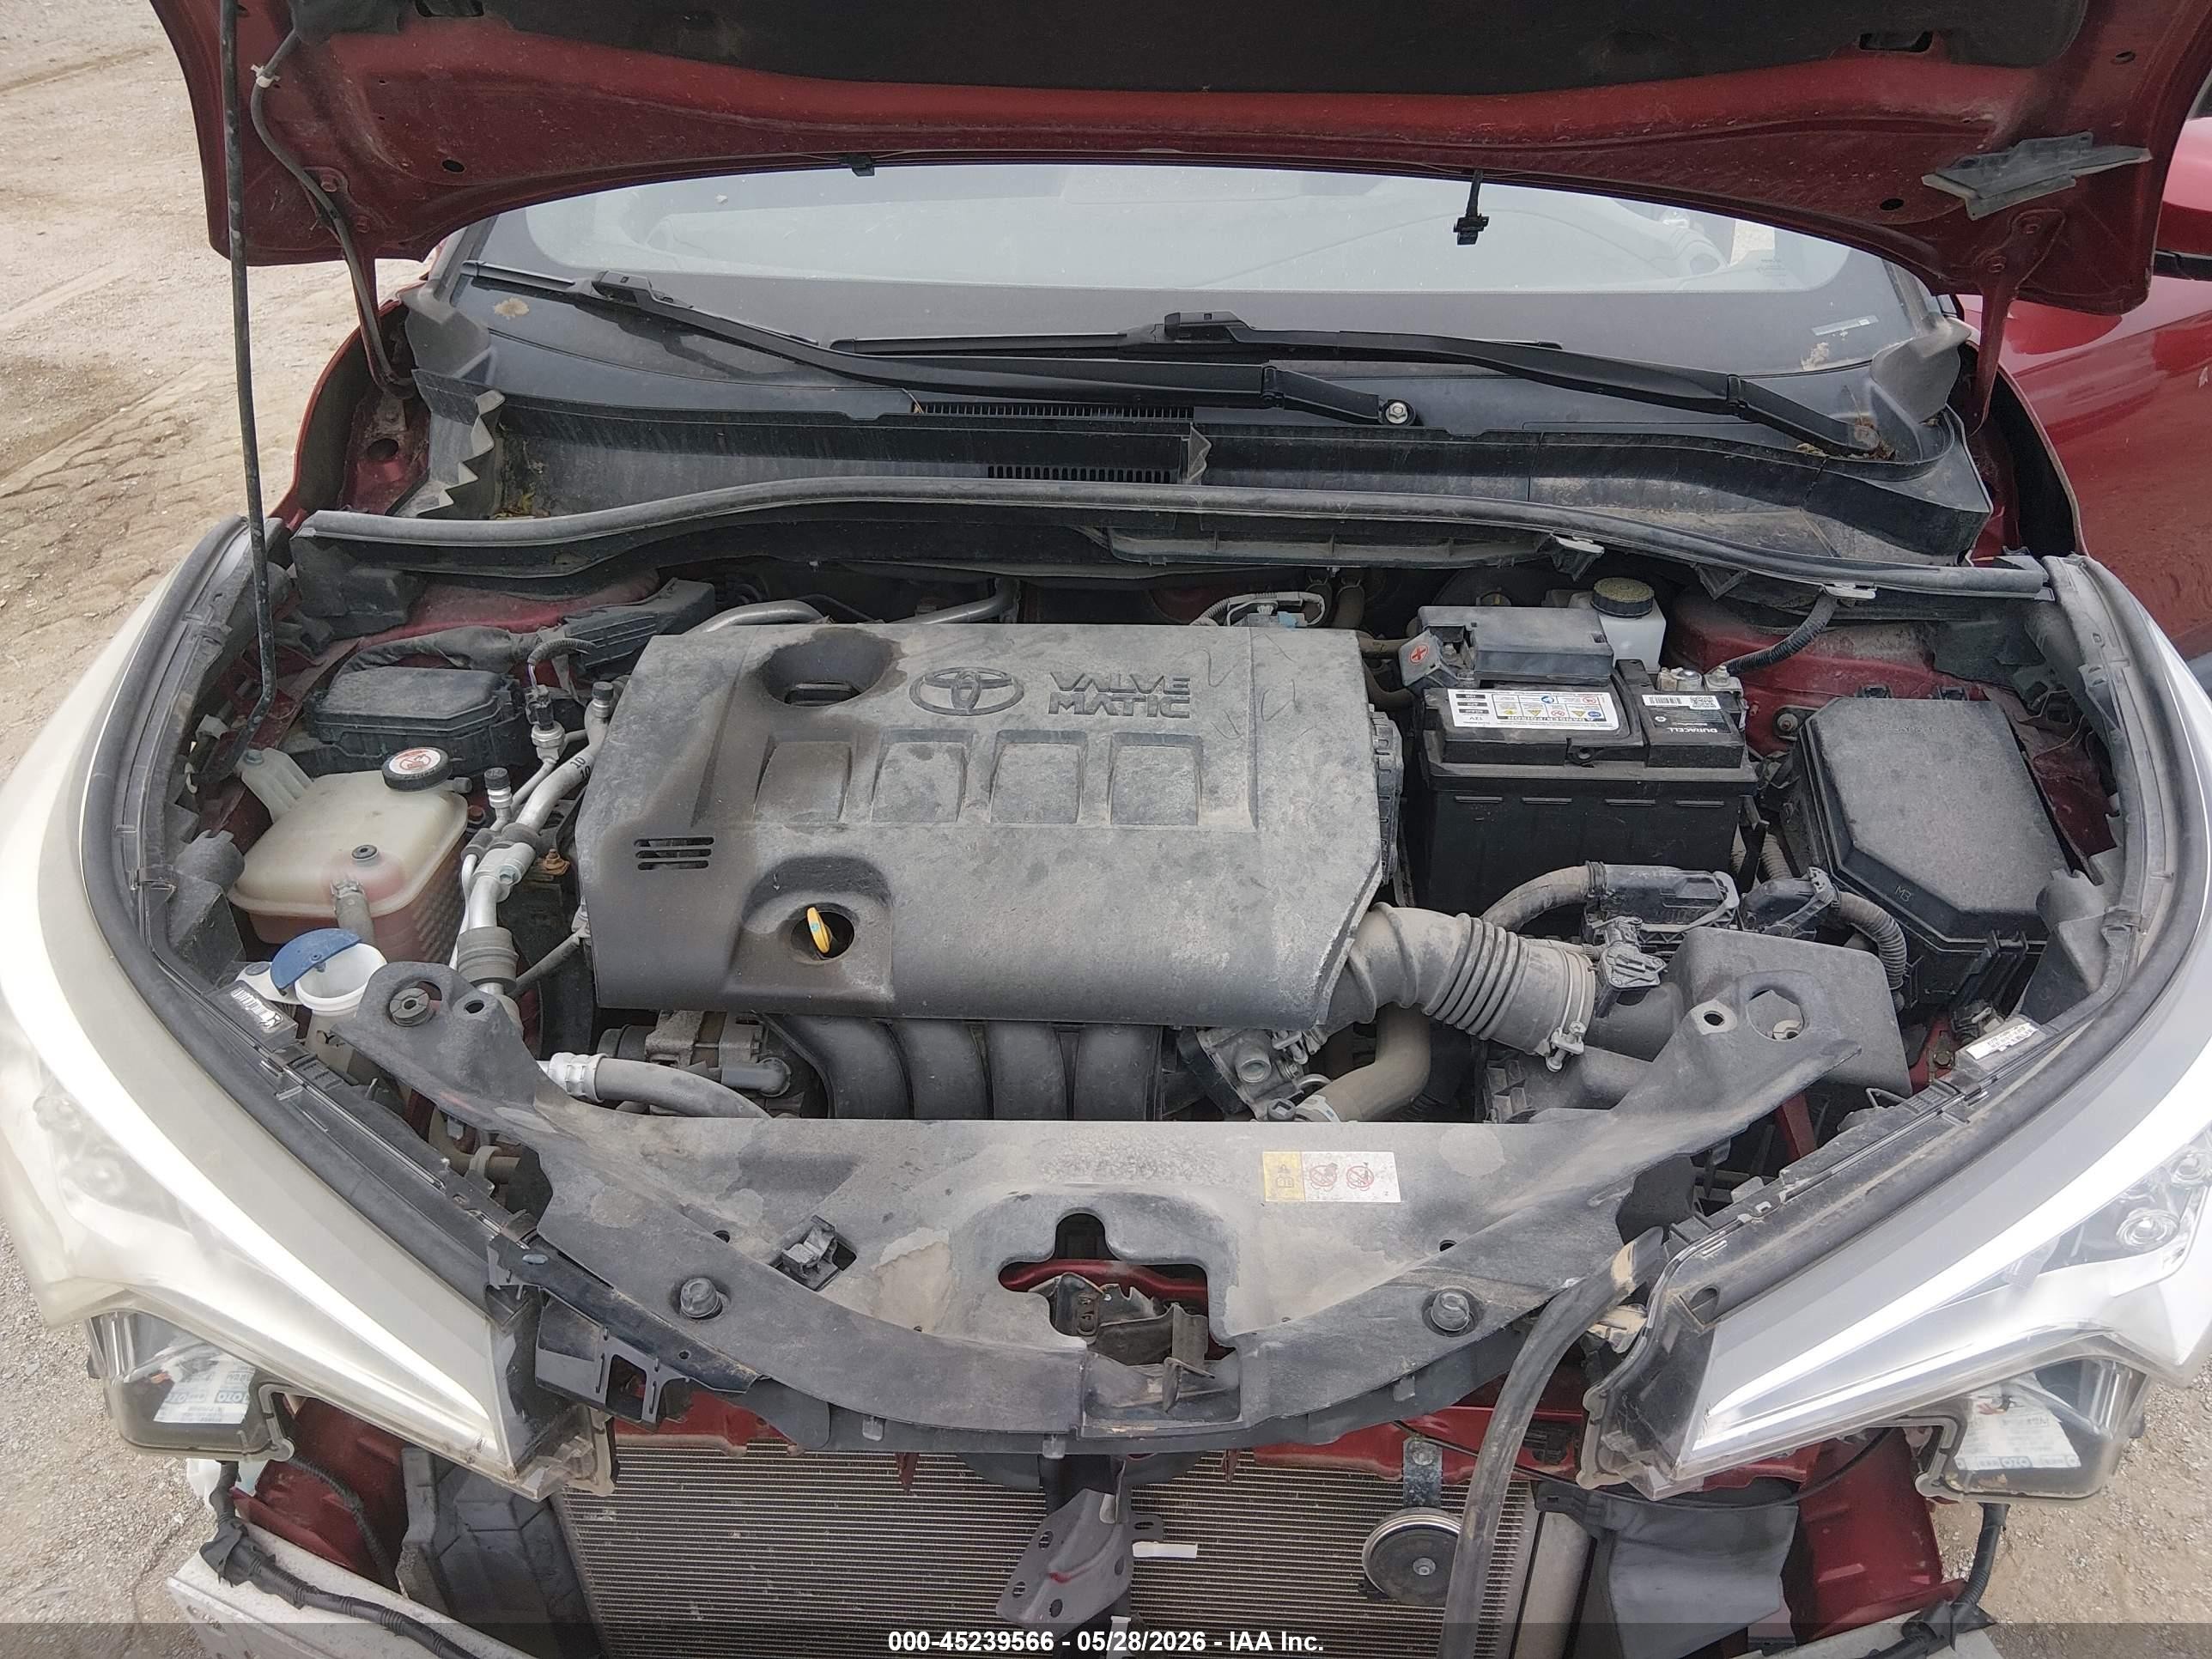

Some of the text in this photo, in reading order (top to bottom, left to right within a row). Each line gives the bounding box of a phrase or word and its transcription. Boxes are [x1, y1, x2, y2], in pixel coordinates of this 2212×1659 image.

[1049, 672, 1190, 696] VALVE
[1048, 692, 1190, 719] MATIC
[569, 757, 586, 769] 10
